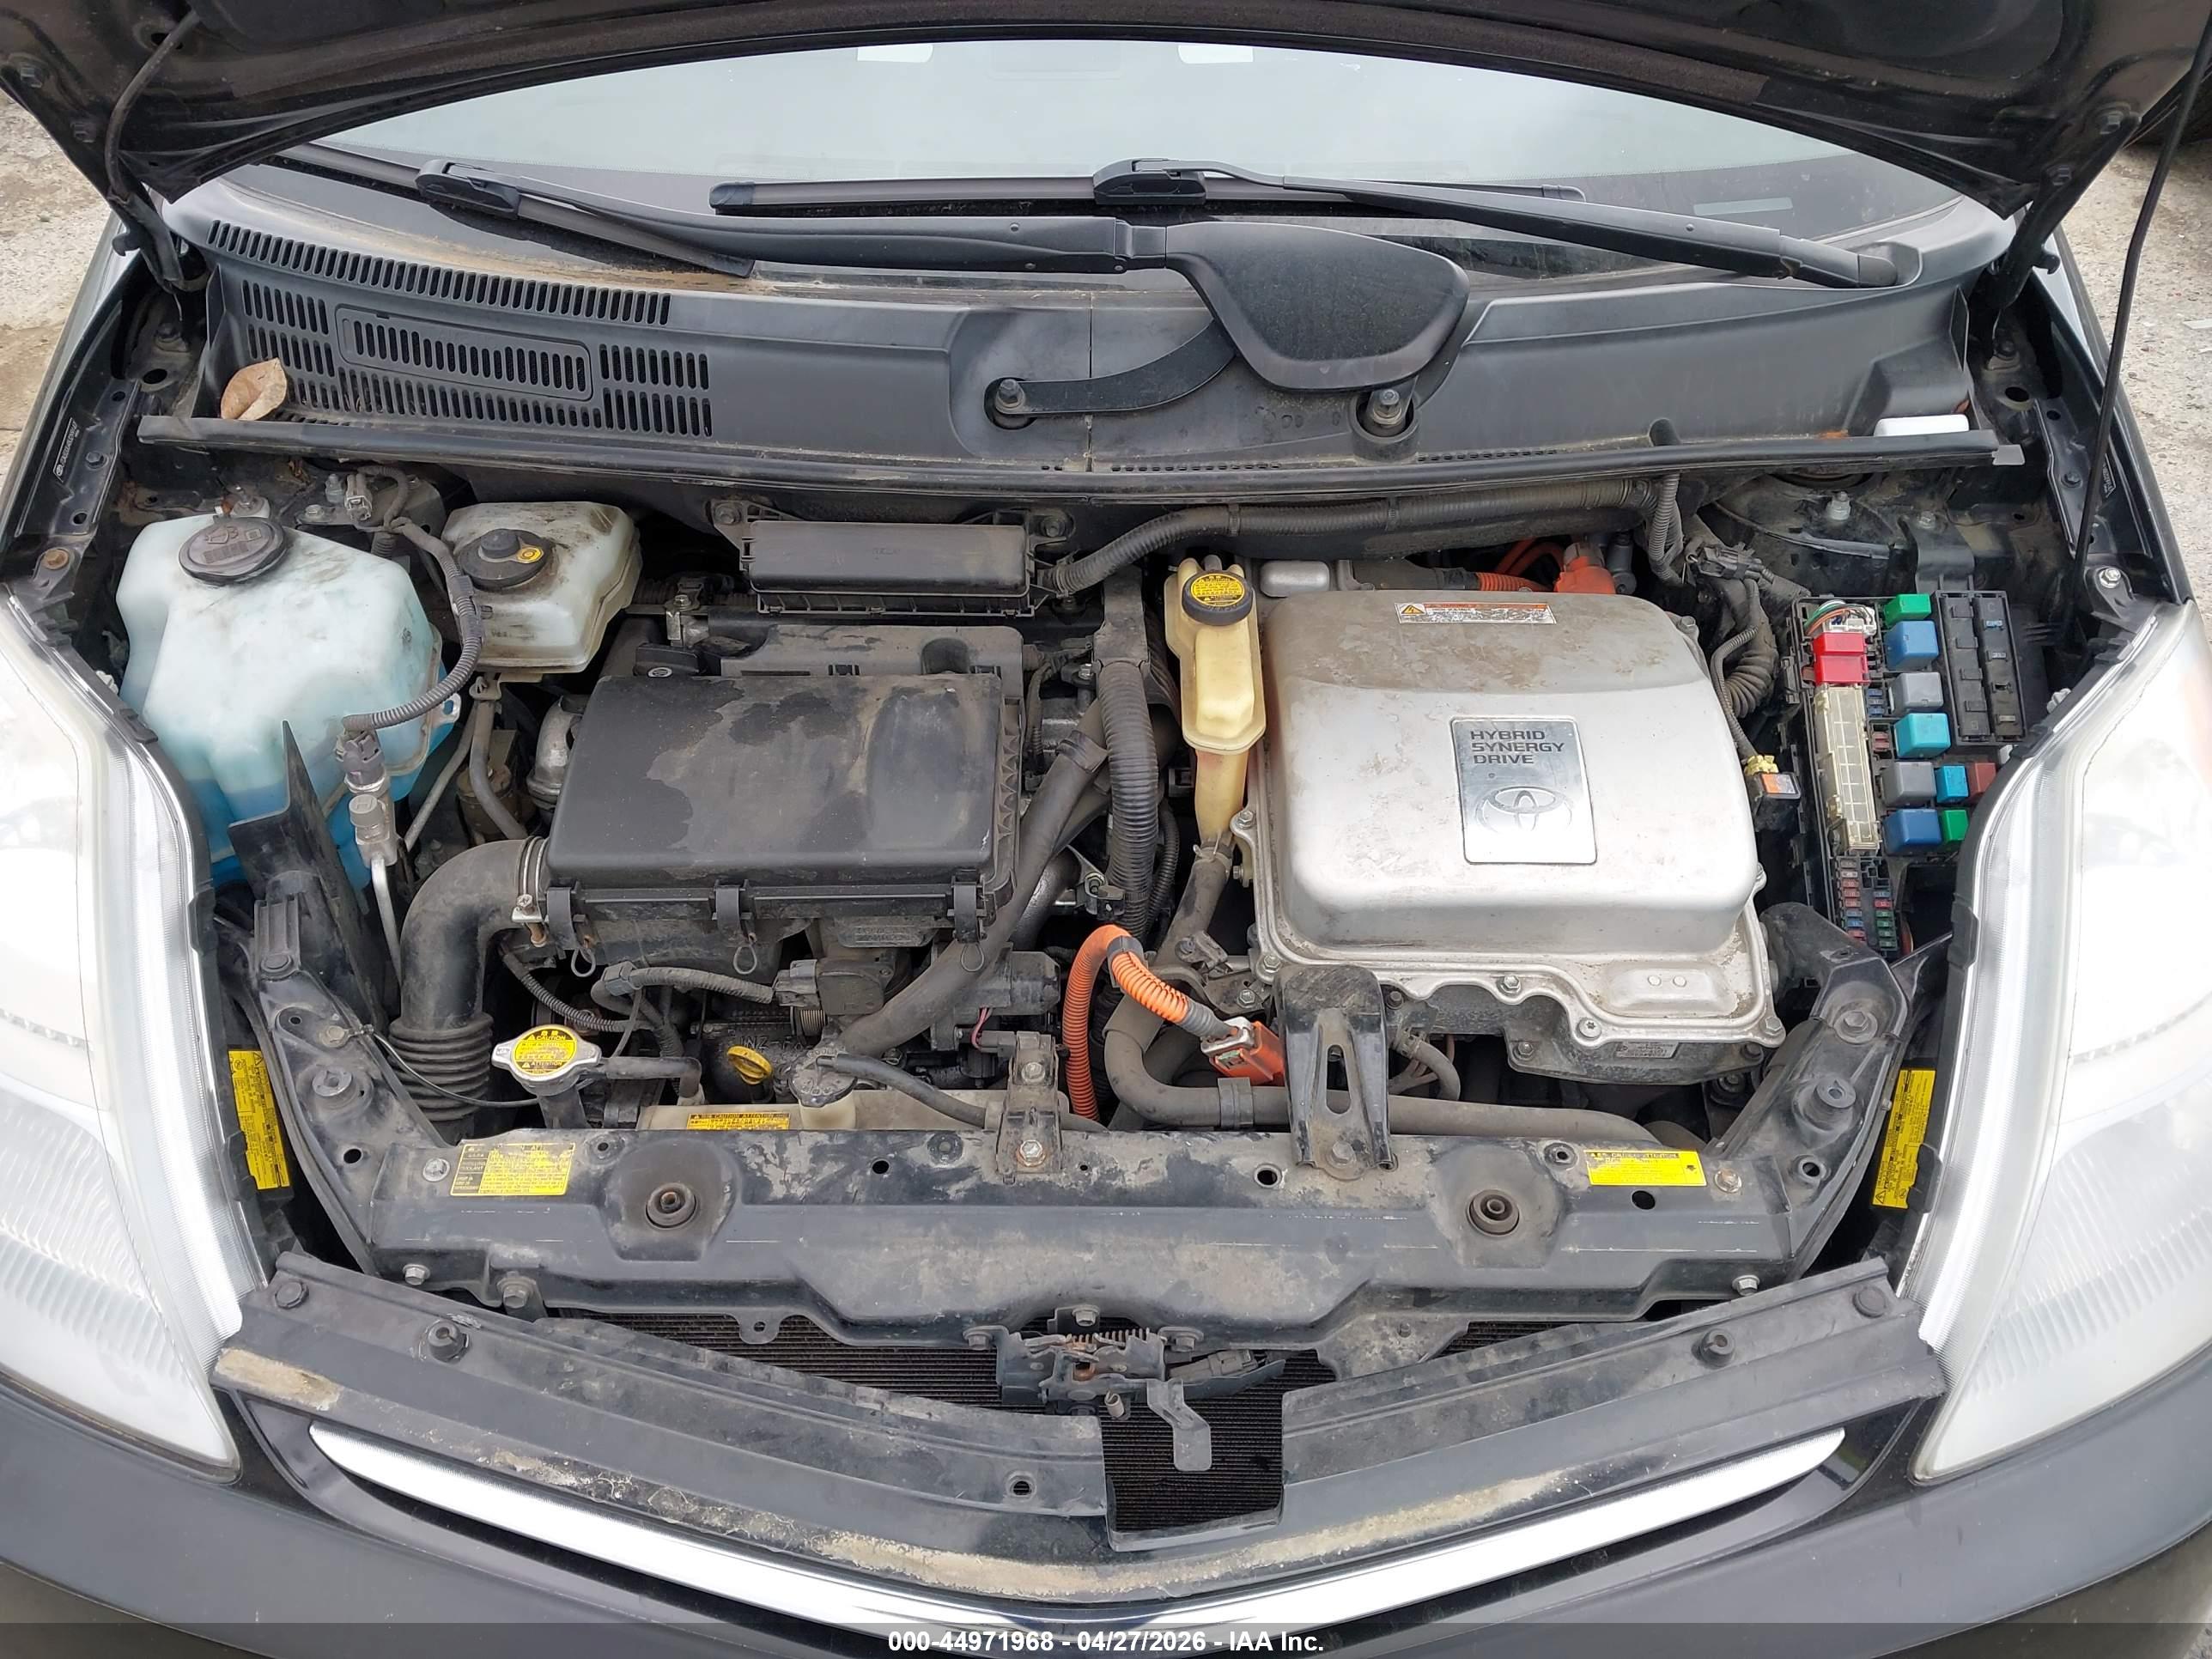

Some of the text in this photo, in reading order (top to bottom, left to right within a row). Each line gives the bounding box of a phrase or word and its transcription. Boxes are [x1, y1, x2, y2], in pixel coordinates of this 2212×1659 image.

[1470, 730, 1546, 740] HYBRID
[1471, 742, 1565, 752] SYNERGY
[1474, 754, 1534, 764] DRIVE
